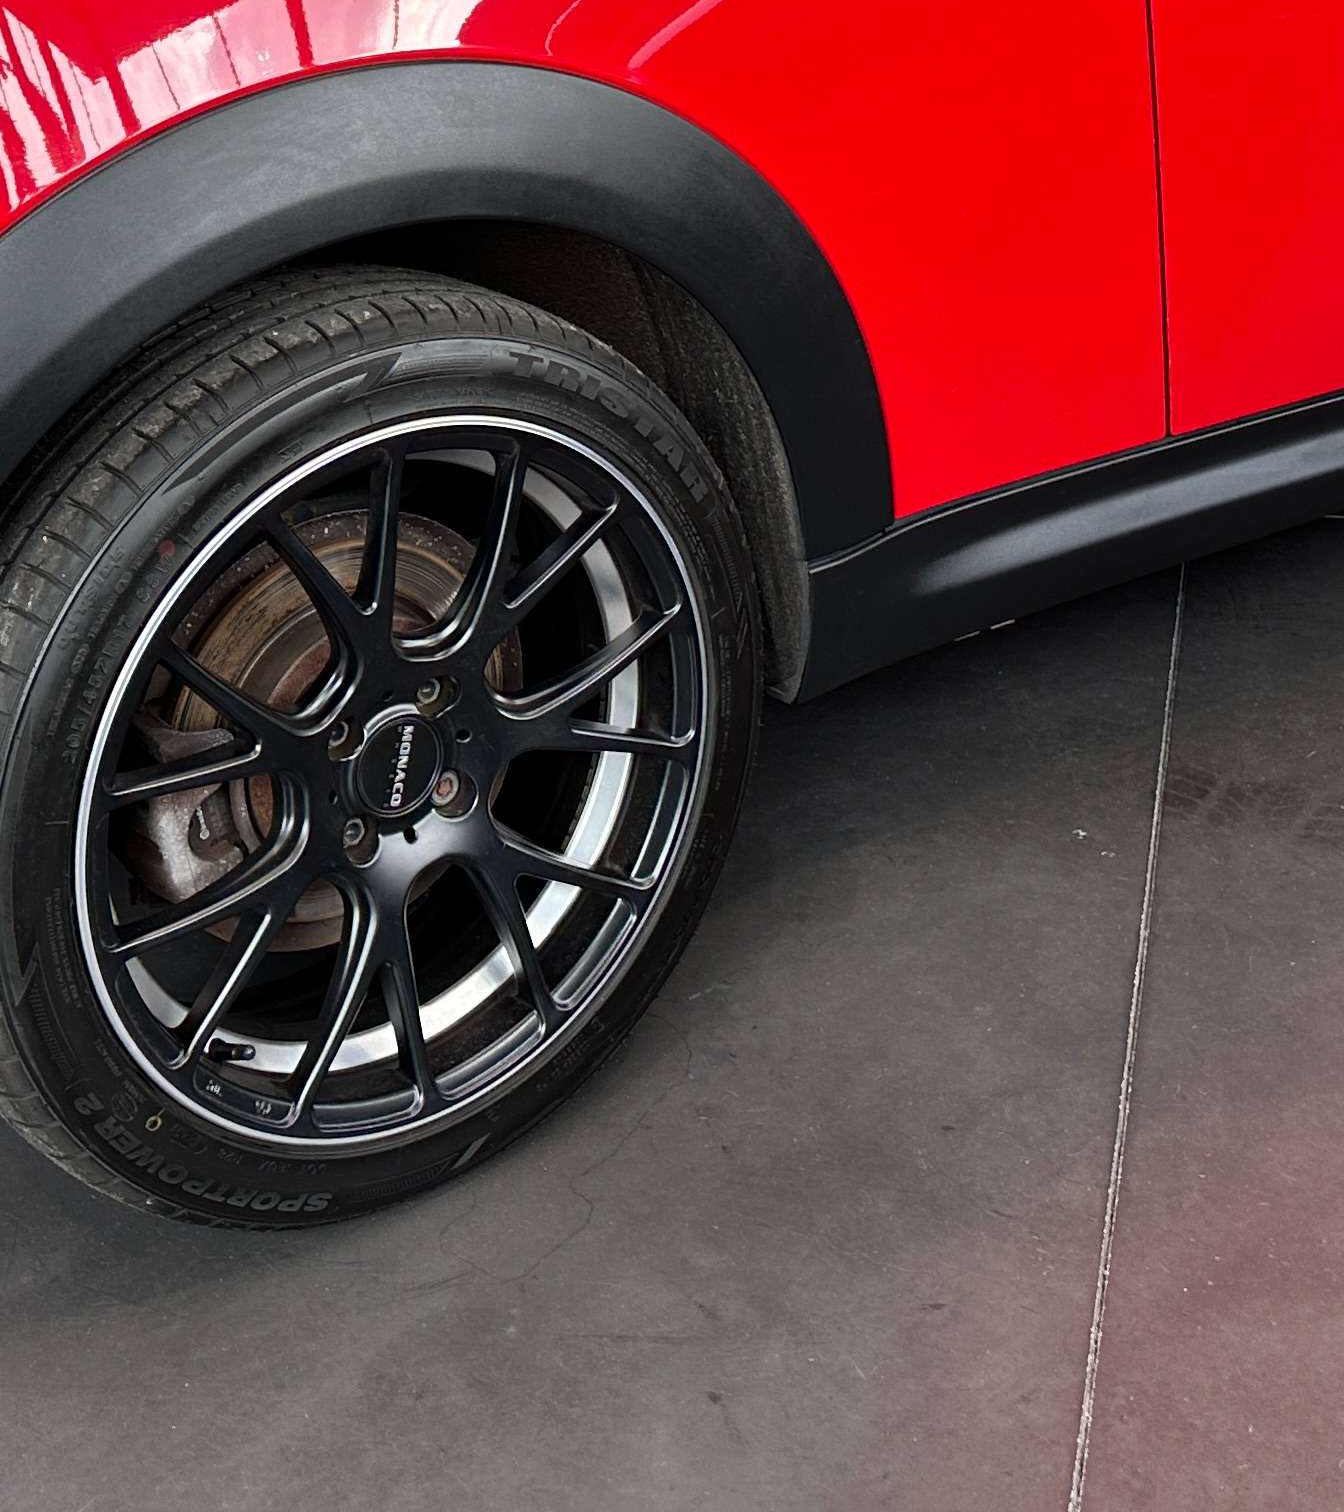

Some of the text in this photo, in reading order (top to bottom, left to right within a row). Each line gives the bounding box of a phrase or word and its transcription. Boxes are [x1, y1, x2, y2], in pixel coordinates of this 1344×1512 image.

[390, 725, 415, 807] MONACO
[72, 1091, 105, 1116] 2
[94, 1114, 333, 1213] SPORTPOWER
